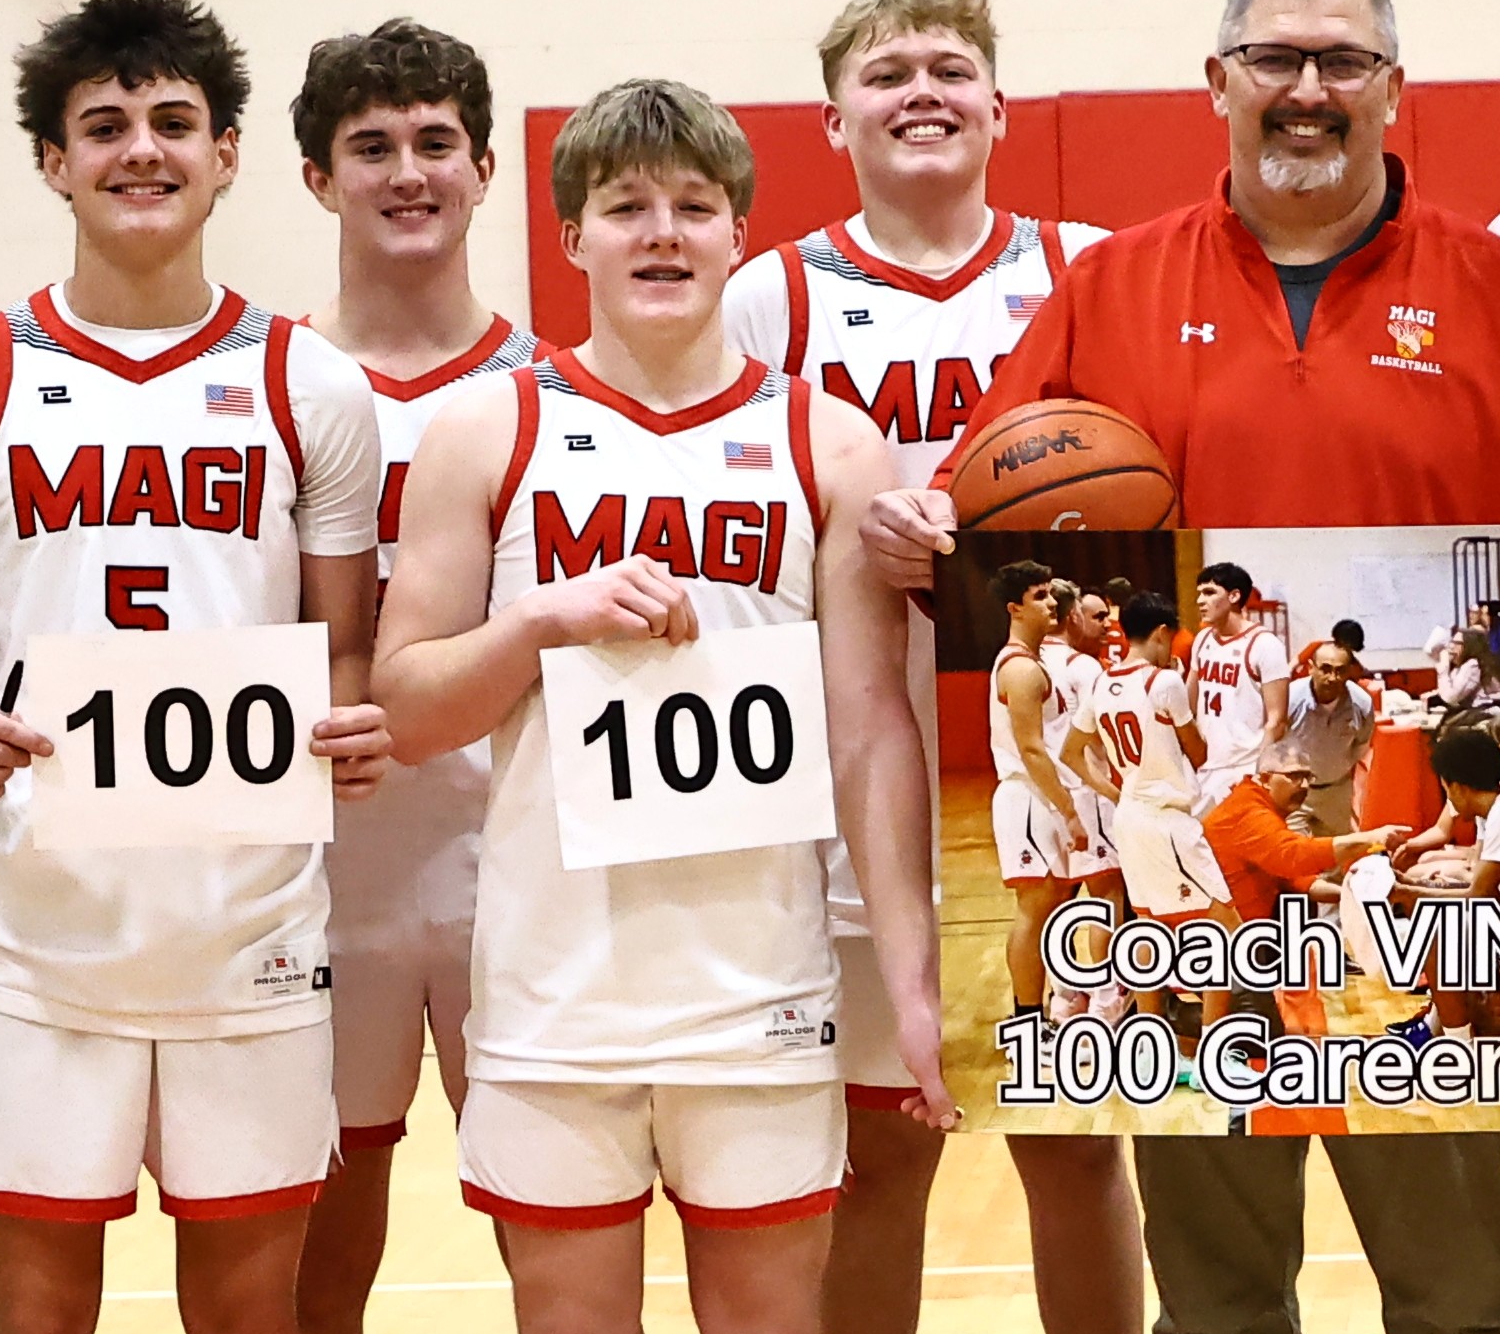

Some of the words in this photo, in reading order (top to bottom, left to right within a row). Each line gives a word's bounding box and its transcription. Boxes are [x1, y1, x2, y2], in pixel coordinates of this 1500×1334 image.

[1388, 305, 1436, 327] MAGI
[1370, 354, 1443, 375] BASKETBALL
[7, 445, 268, 541] MAGI
[533, 490, 787, 595] MAGI
[1108, 644, 1123, 664] 5
[1198, 660, 1241, 688] MAGI
[65, 683, 296, 789] 100
[1099, 711, 1143, 768] 10
[1204, 690, 1223, 717] 14
[582, 682, 795, 802] 100
[1042, 894, 1347, 991] Coach
[994, 1013, 1180, 1109] 100
